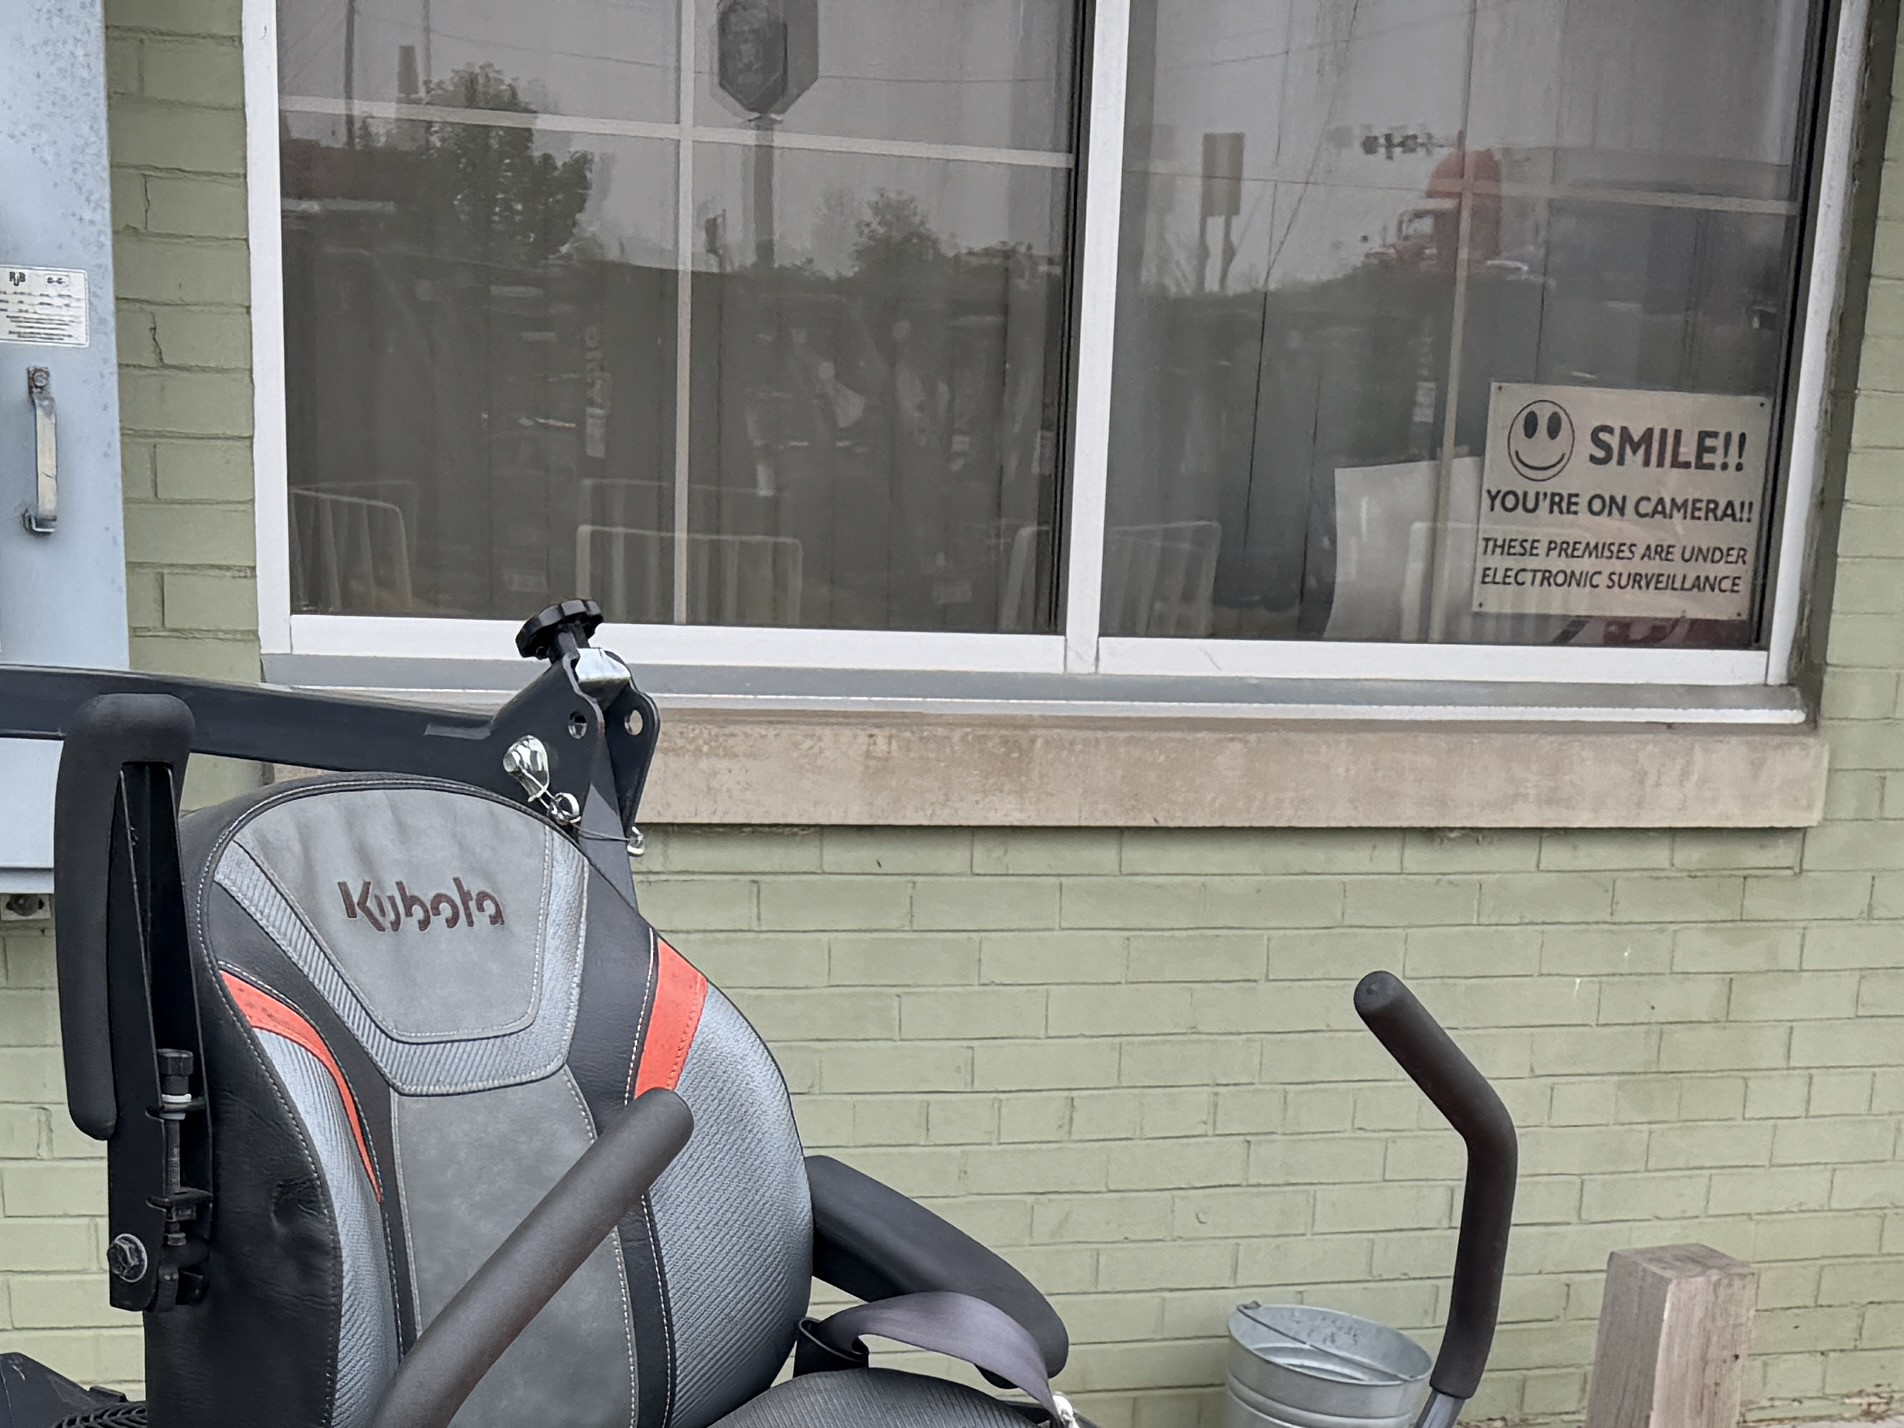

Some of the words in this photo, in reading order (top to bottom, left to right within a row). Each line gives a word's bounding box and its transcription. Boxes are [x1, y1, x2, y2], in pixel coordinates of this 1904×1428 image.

[1588, 424, 1747, 473] SMILE!!
[1485, 489, 1581, 516] YOU'RE
[1587, 493, 1627, 518] ON
[1633, 497, 1754, 524] CAMERA!!
[1481, 536, 1541, 558] THESE
[1546, 540, 1638, 561] PREMISES
[1640, 544, 1676, 563] ARE
[1680, 546, 1748, 566] UNDER
[1480, 566, 1603, 590] ELECTRONIC
[1606, 571, 1742, 594] SURVEILLANCE
[337, 876, 505, 932] Kubota
